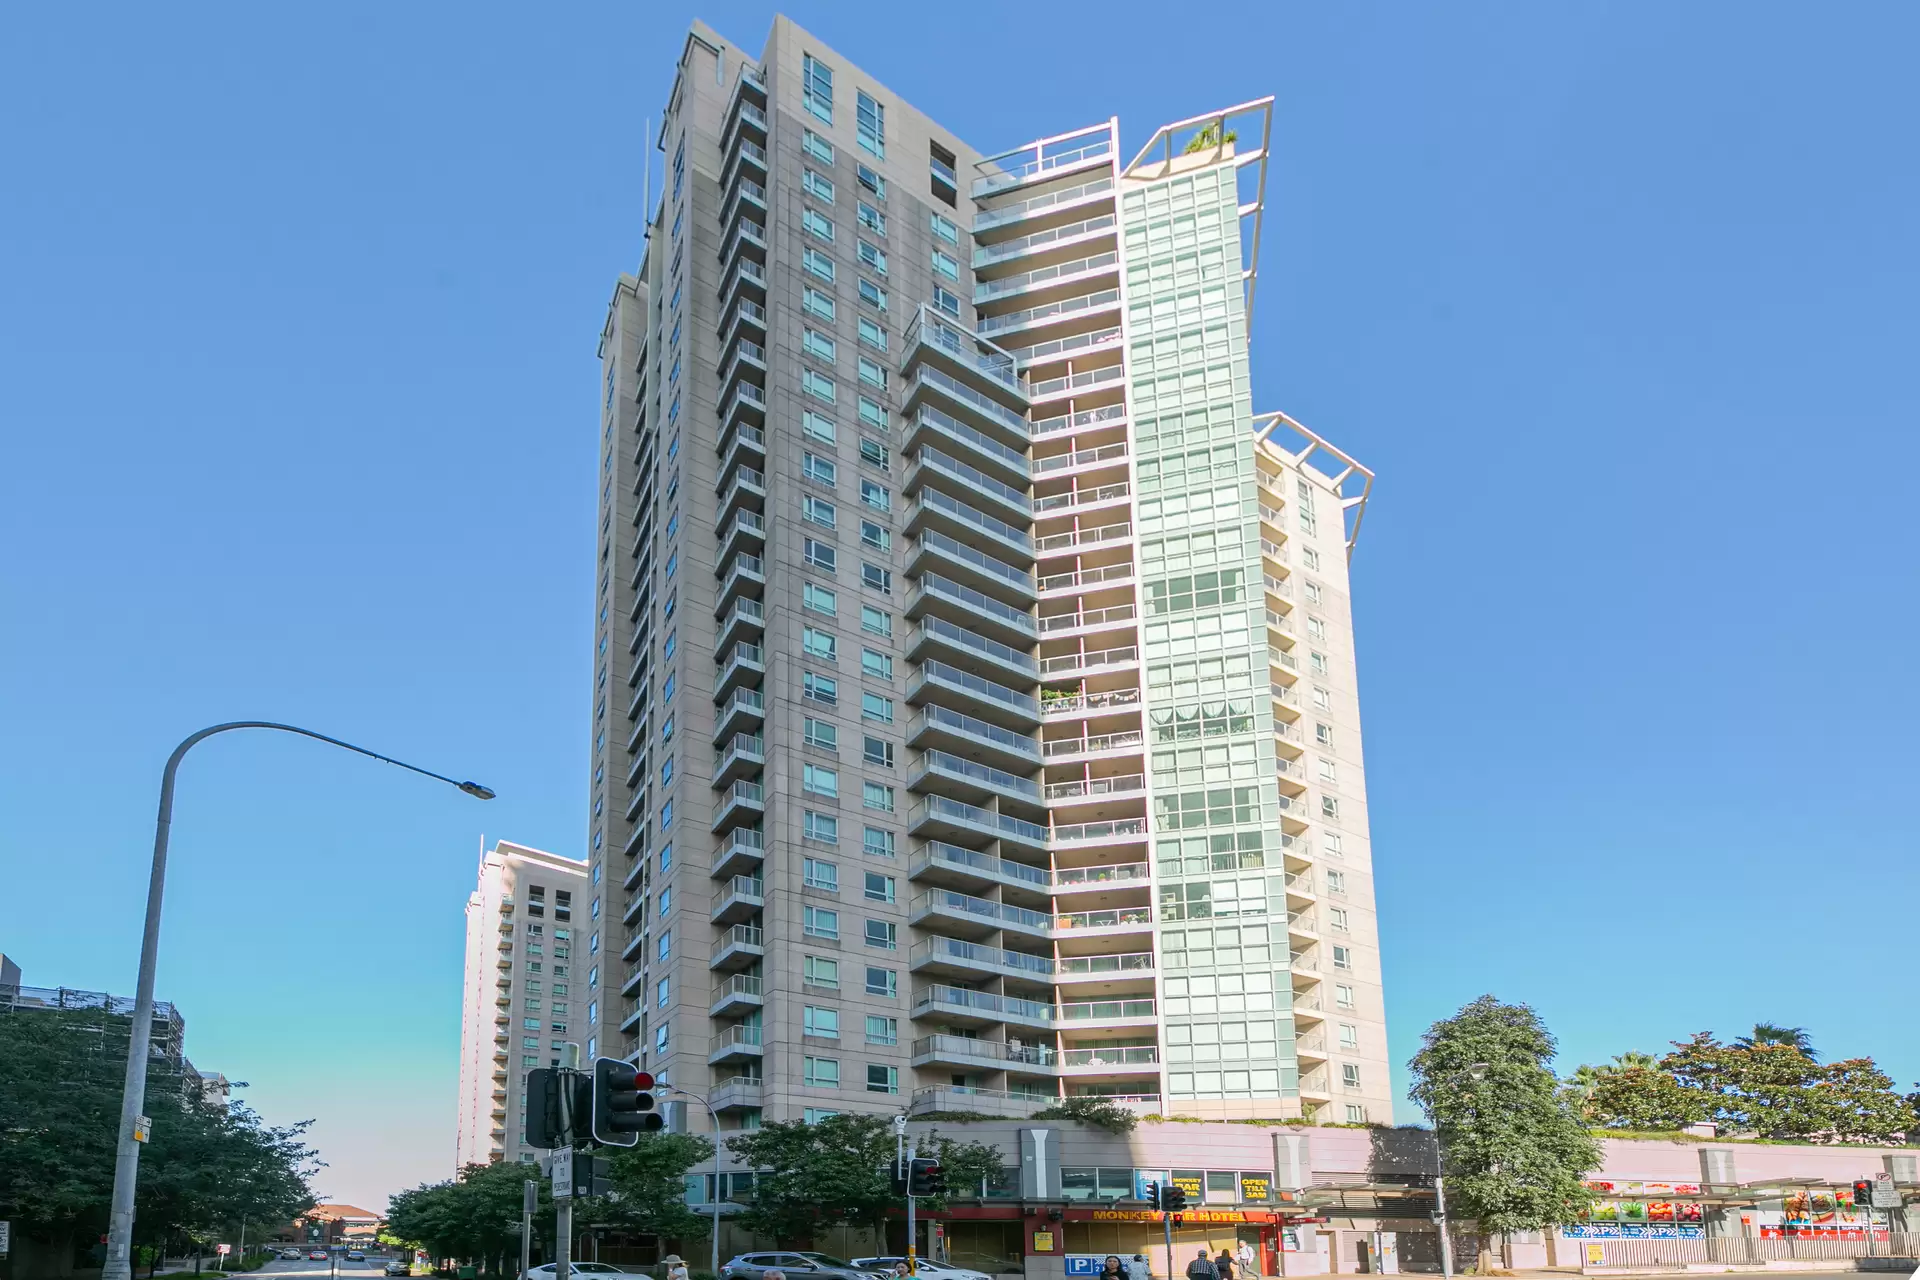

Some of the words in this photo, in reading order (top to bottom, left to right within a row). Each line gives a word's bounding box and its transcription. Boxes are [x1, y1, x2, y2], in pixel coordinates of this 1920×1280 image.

[1175, 1183, 1201, 1191] BAR
[1093, 1211, 1161, 1220] MONKEY
[1199, 1211, 1247, 1221] HOTEL
[1075, 1259, 1088, 1271] P
